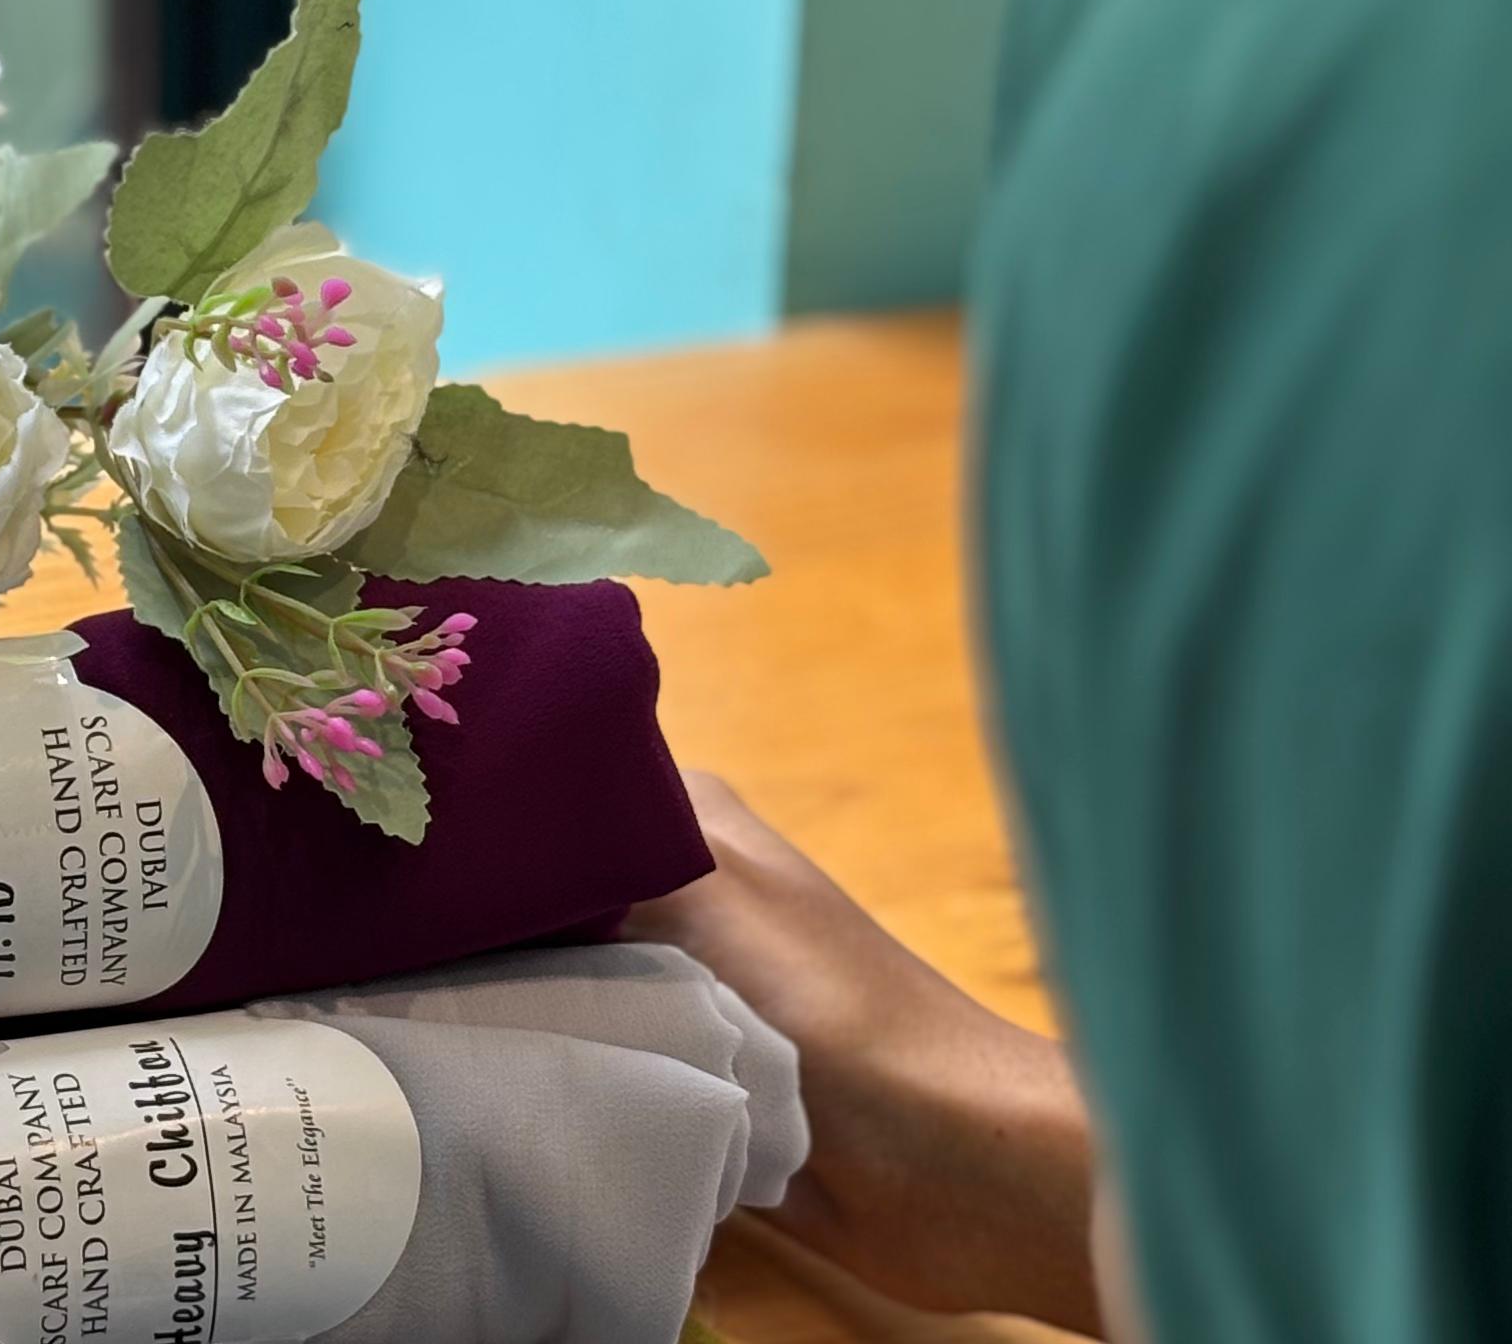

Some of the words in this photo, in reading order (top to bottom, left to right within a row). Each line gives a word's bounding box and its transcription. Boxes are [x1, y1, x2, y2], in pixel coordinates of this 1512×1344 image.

[42, 727, 81, 833] HAND
[81, 716, 123, 821] SCARF
[99, 831, 129, 987] COMPANY
[135, 799, 168, 910] DUBAI
[59, 845, 89, 986] CRAFTED
[9, 1072, 65, 1240] COMPANY
[54, 1072, 107, 1225] CRAFTED
[128, 1039, 198, 1188] Chiffon
[210, 1064, 253, 1184] MALAYSIA
[234, 1194, 256, 1225] IN
[298, 1174, 325, 1210] The
[79, 1237, 109, 1336] HAND
[236, 1233, 258, 1301] MADE
